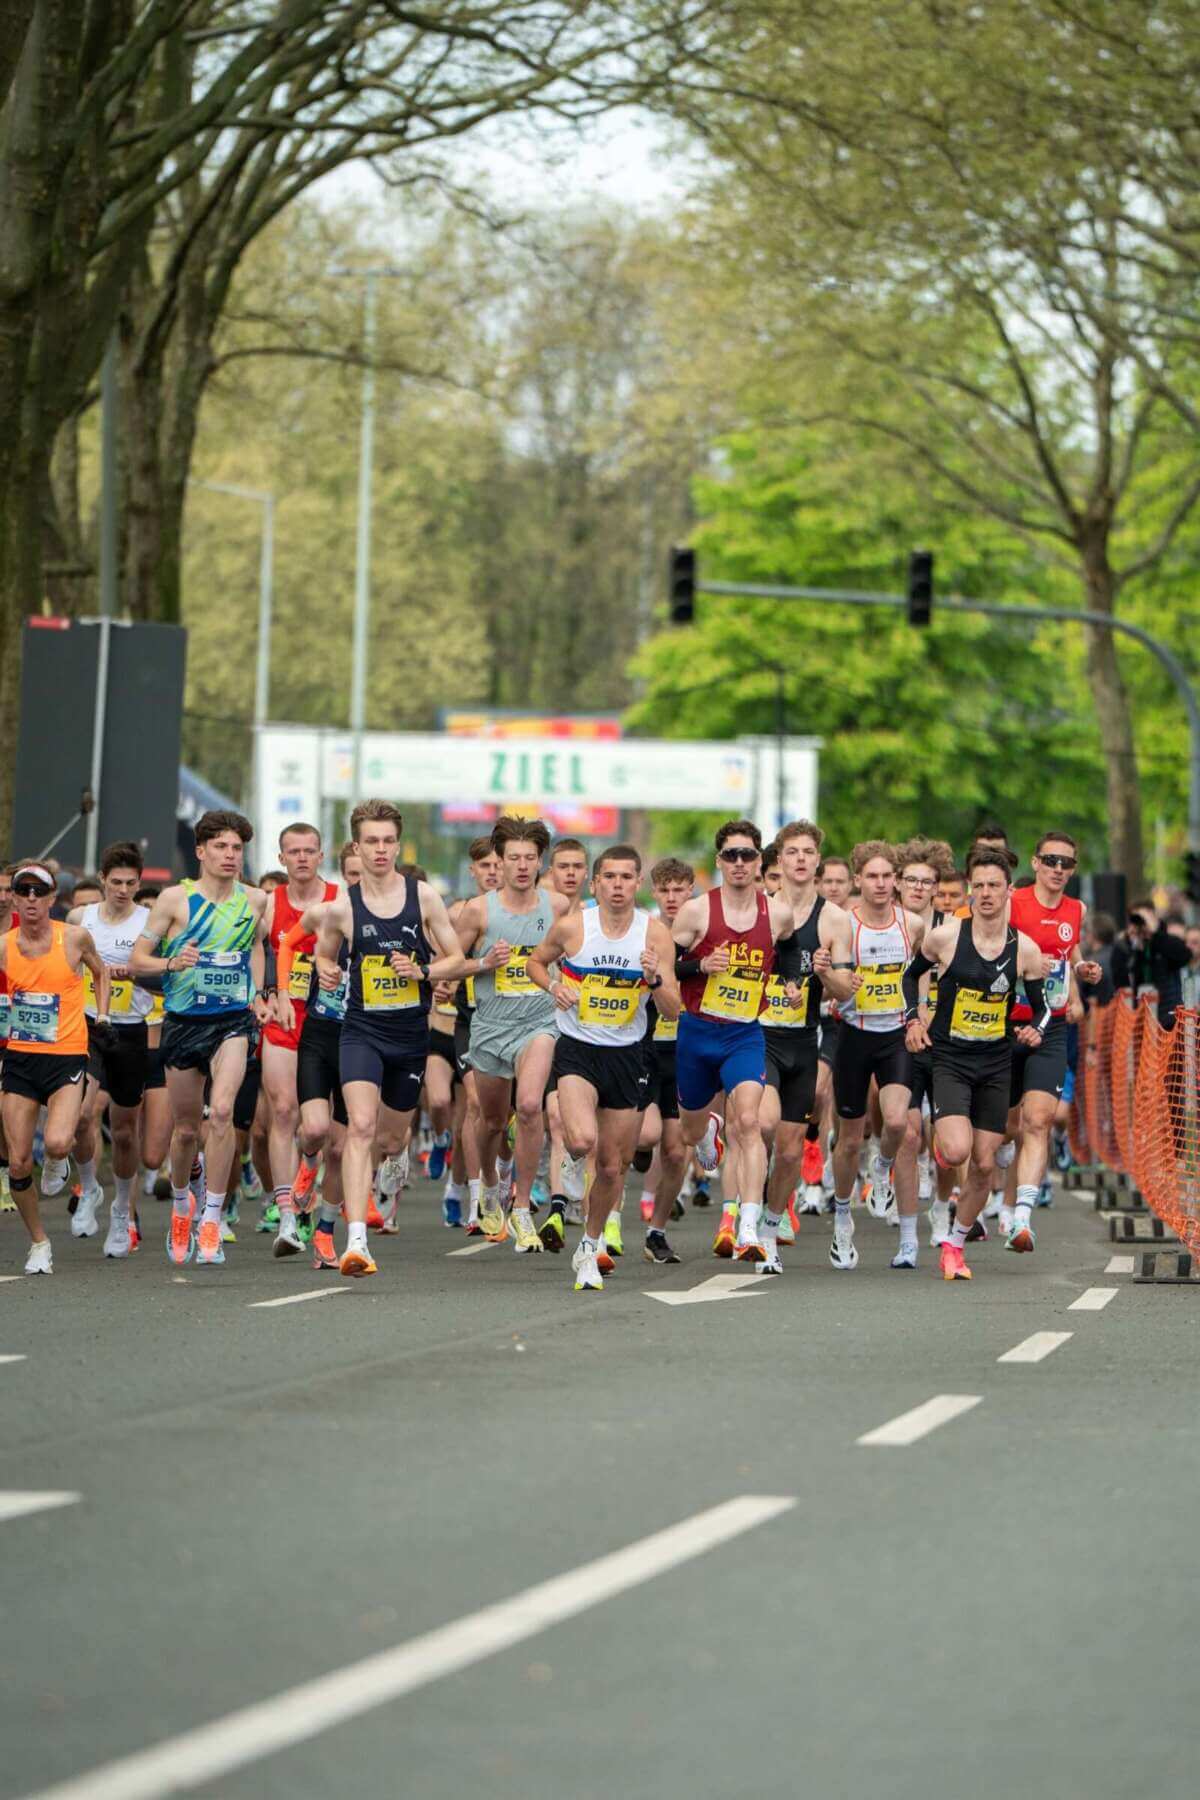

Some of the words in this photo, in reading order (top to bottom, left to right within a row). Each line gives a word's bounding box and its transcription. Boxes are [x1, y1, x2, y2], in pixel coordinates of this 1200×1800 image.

[489, 752, 586, 793] ZIEL
[115, 939, 135, 948] LAC
[592, 954, 630, 969] HANAU
[506, 966, 526, 979] 56
[203, 973, 241, 986] 5909
[373, 977, 409, 990] 7216
[718, 986, 750, 1002] 7211
[866, 984, 898, 996] 7231
[589, 996, 630, 1011] 5908
[18, 1011, 50, 1024] 5733
[962, 1010, 999, 1024] 7264
